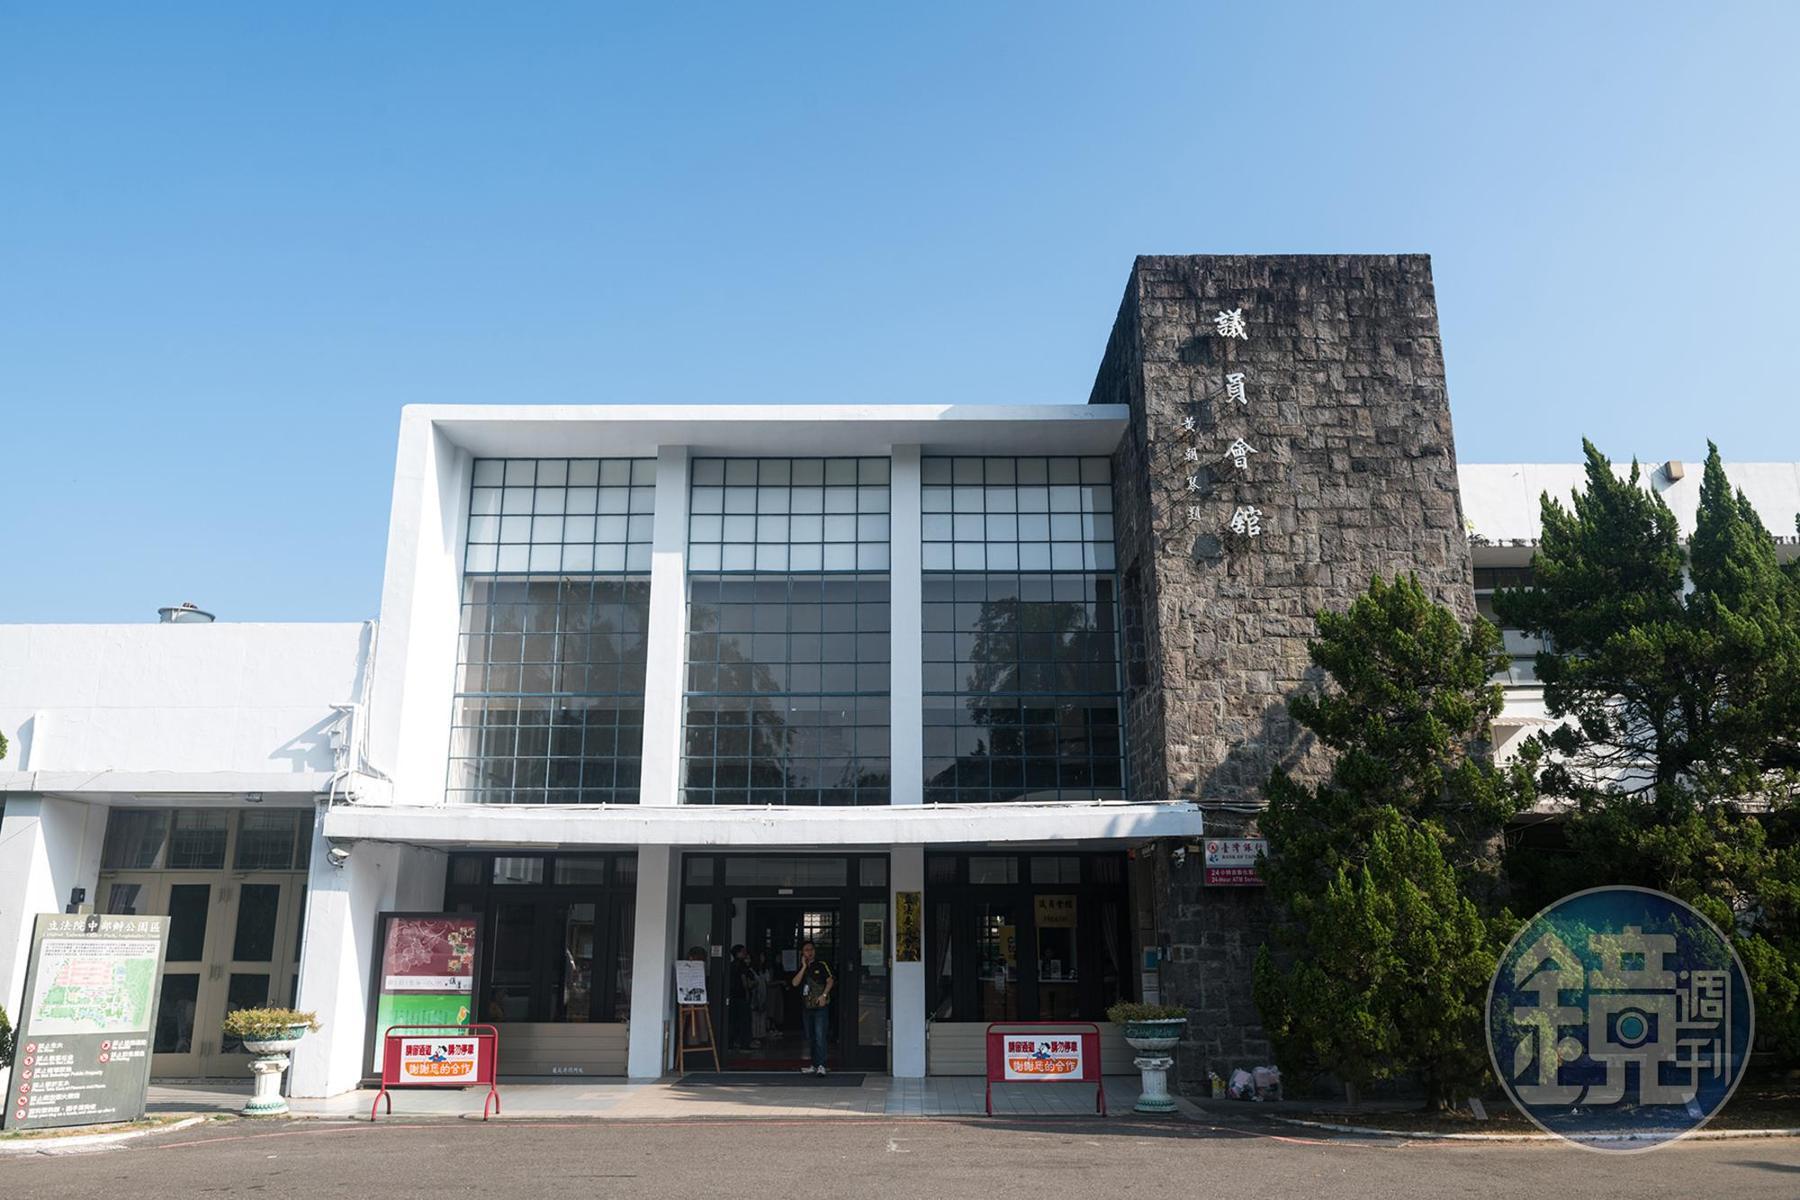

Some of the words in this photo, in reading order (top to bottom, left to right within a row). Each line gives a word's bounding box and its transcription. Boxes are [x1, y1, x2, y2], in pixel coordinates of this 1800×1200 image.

[1214, 308, 1263, 537] 議員會館
[47, 919, 161, 933] 立法院中部辦公園區
[408, 1063, 471, 1075] 謝謝您的合作
[1013, 1060, 1076, 1072] 謝謝您的合作
